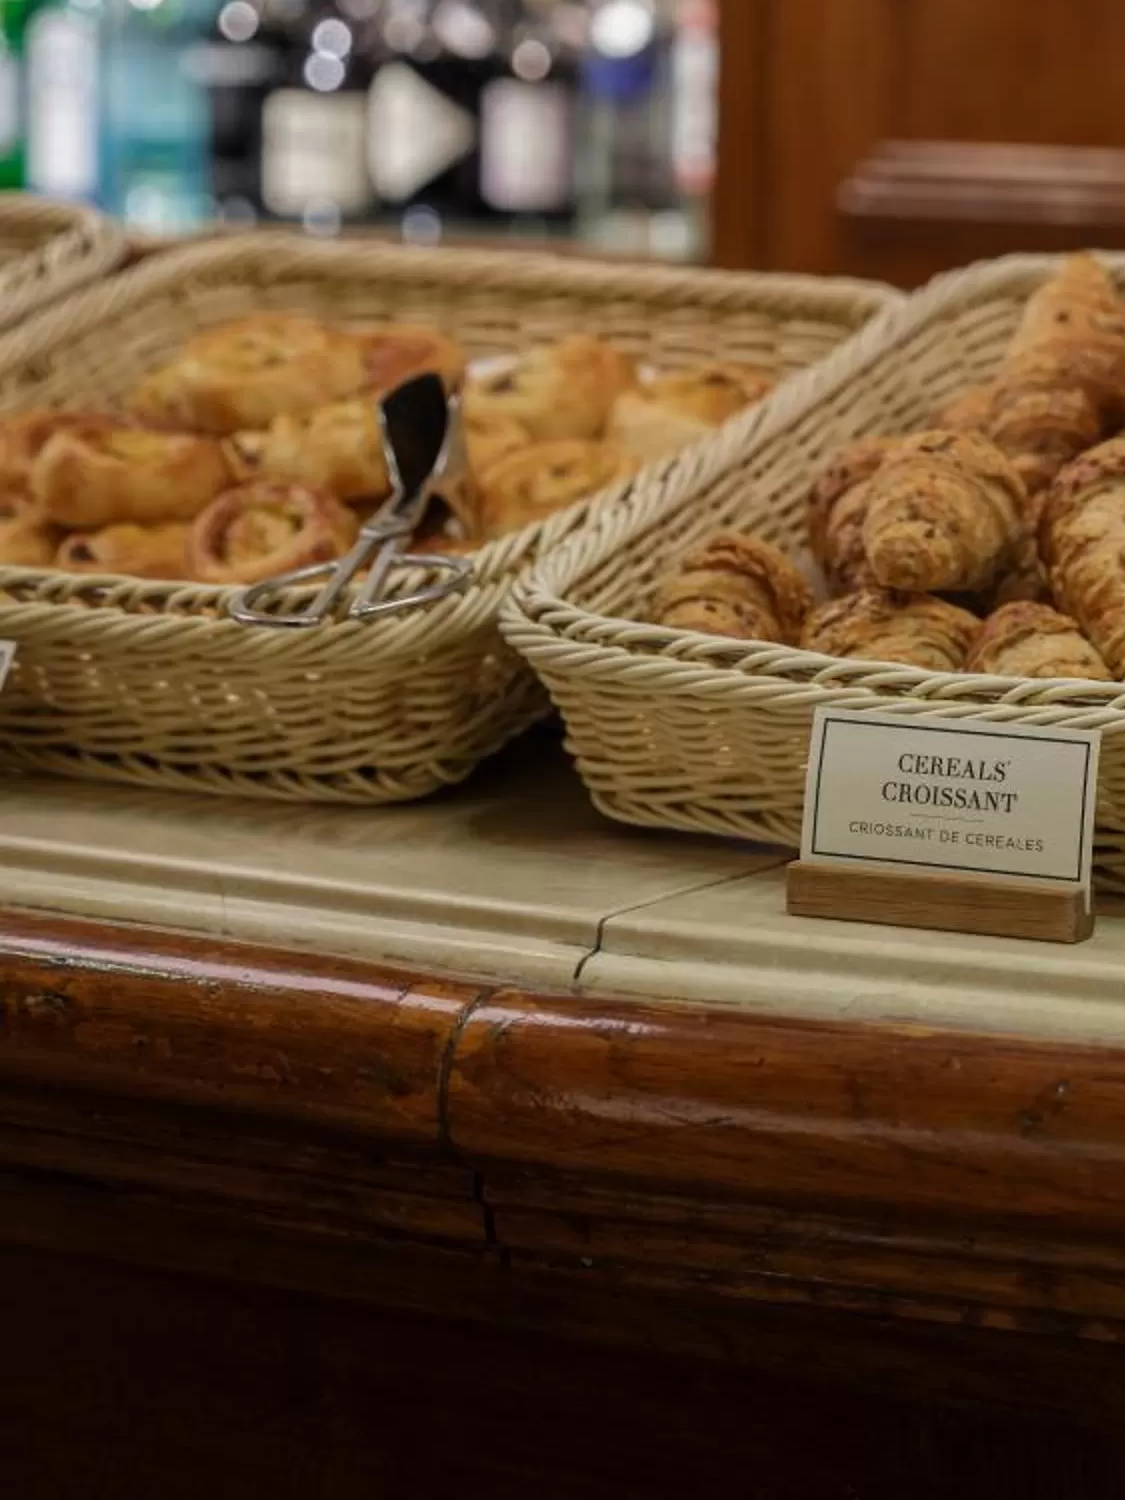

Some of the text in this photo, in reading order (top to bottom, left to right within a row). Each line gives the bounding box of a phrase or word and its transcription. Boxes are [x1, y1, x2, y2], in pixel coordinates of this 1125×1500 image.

[882, 781, 1017, 813] CROISSANT
[849, 821, 1044, 852] CRIOSSANT DE CEREALES
